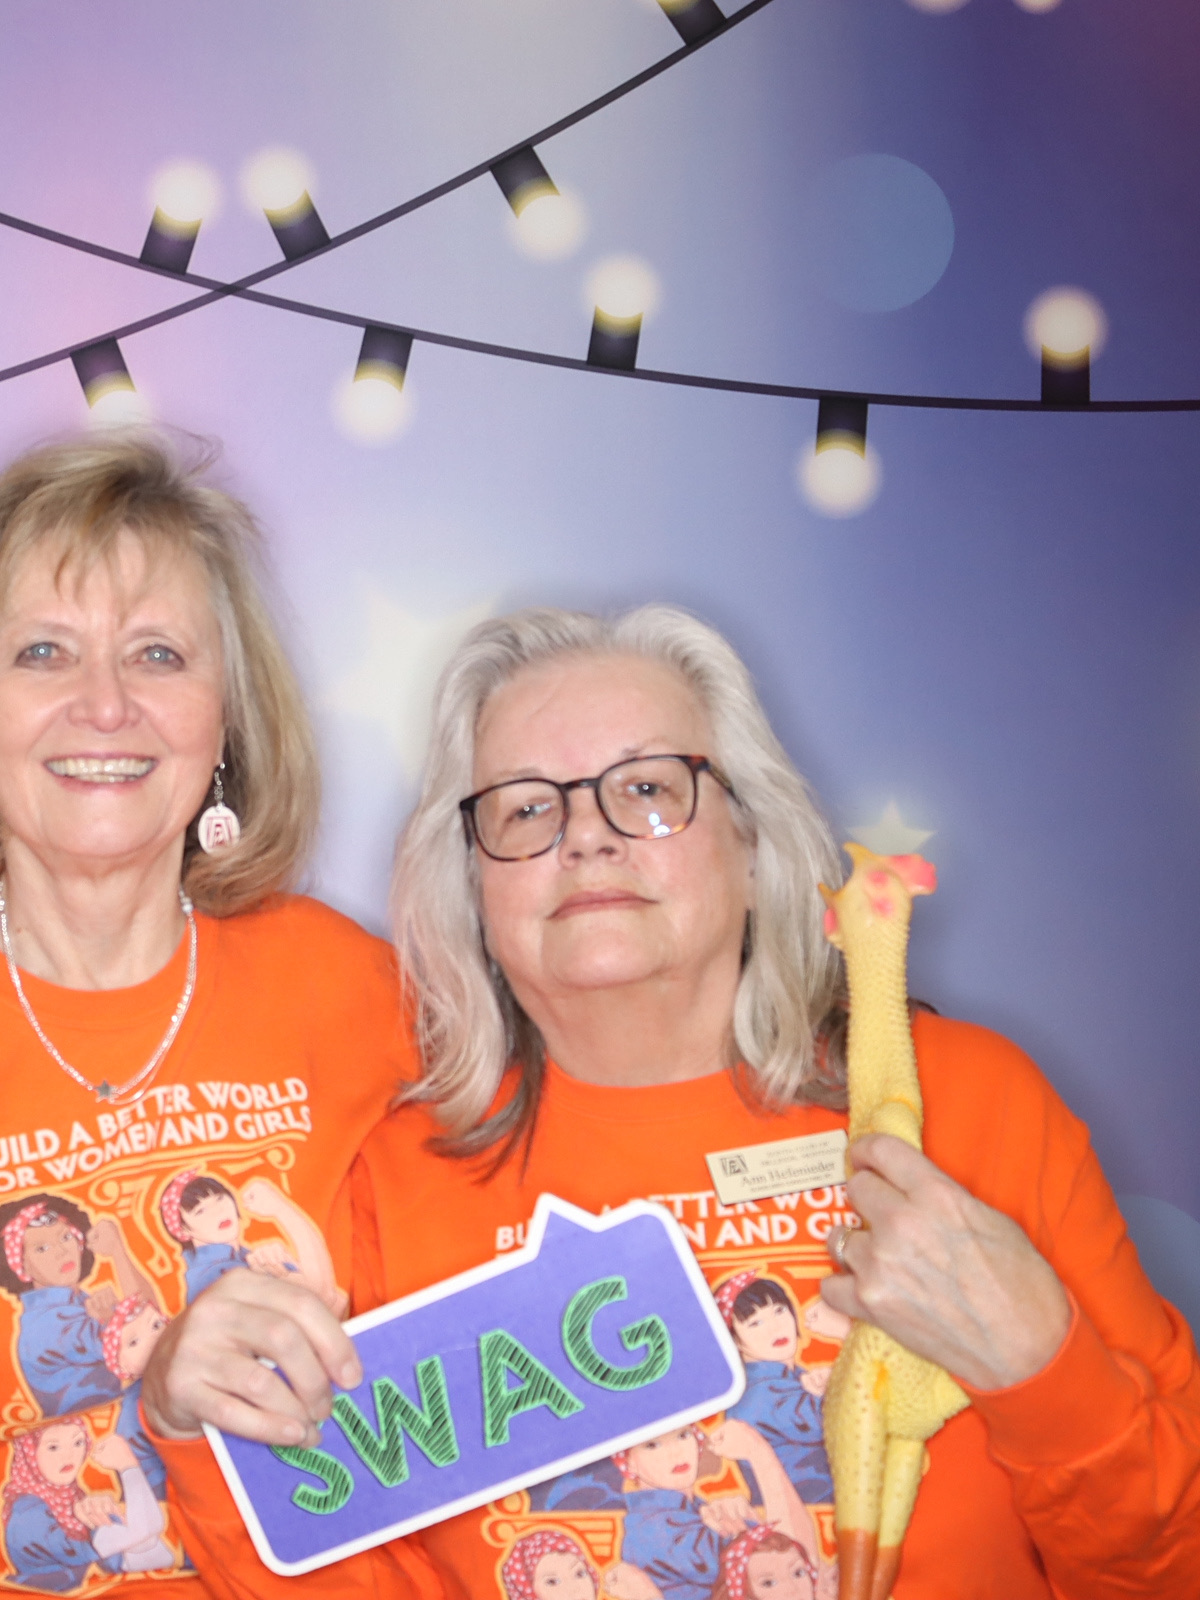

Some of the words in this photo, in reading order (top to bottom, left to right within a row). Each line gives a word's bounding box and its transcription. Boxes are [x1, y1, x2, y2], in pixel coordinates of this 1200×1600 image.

[43, 1120, 160, 1182] WOMEN
[160, 1113, 229, 1149] AND
[234, 1105, 313, 1140] GIRLS
[69, 1121, 95, 1151] A
[96, 1083, 197, 1141] BETTER
[196, 1077, 309, 1111] WORLD
[714, 1213, 798, 1248] AND
[772, 1184, 849, 1211] WOR
[270, 1275, 673, 1515] SWAG
